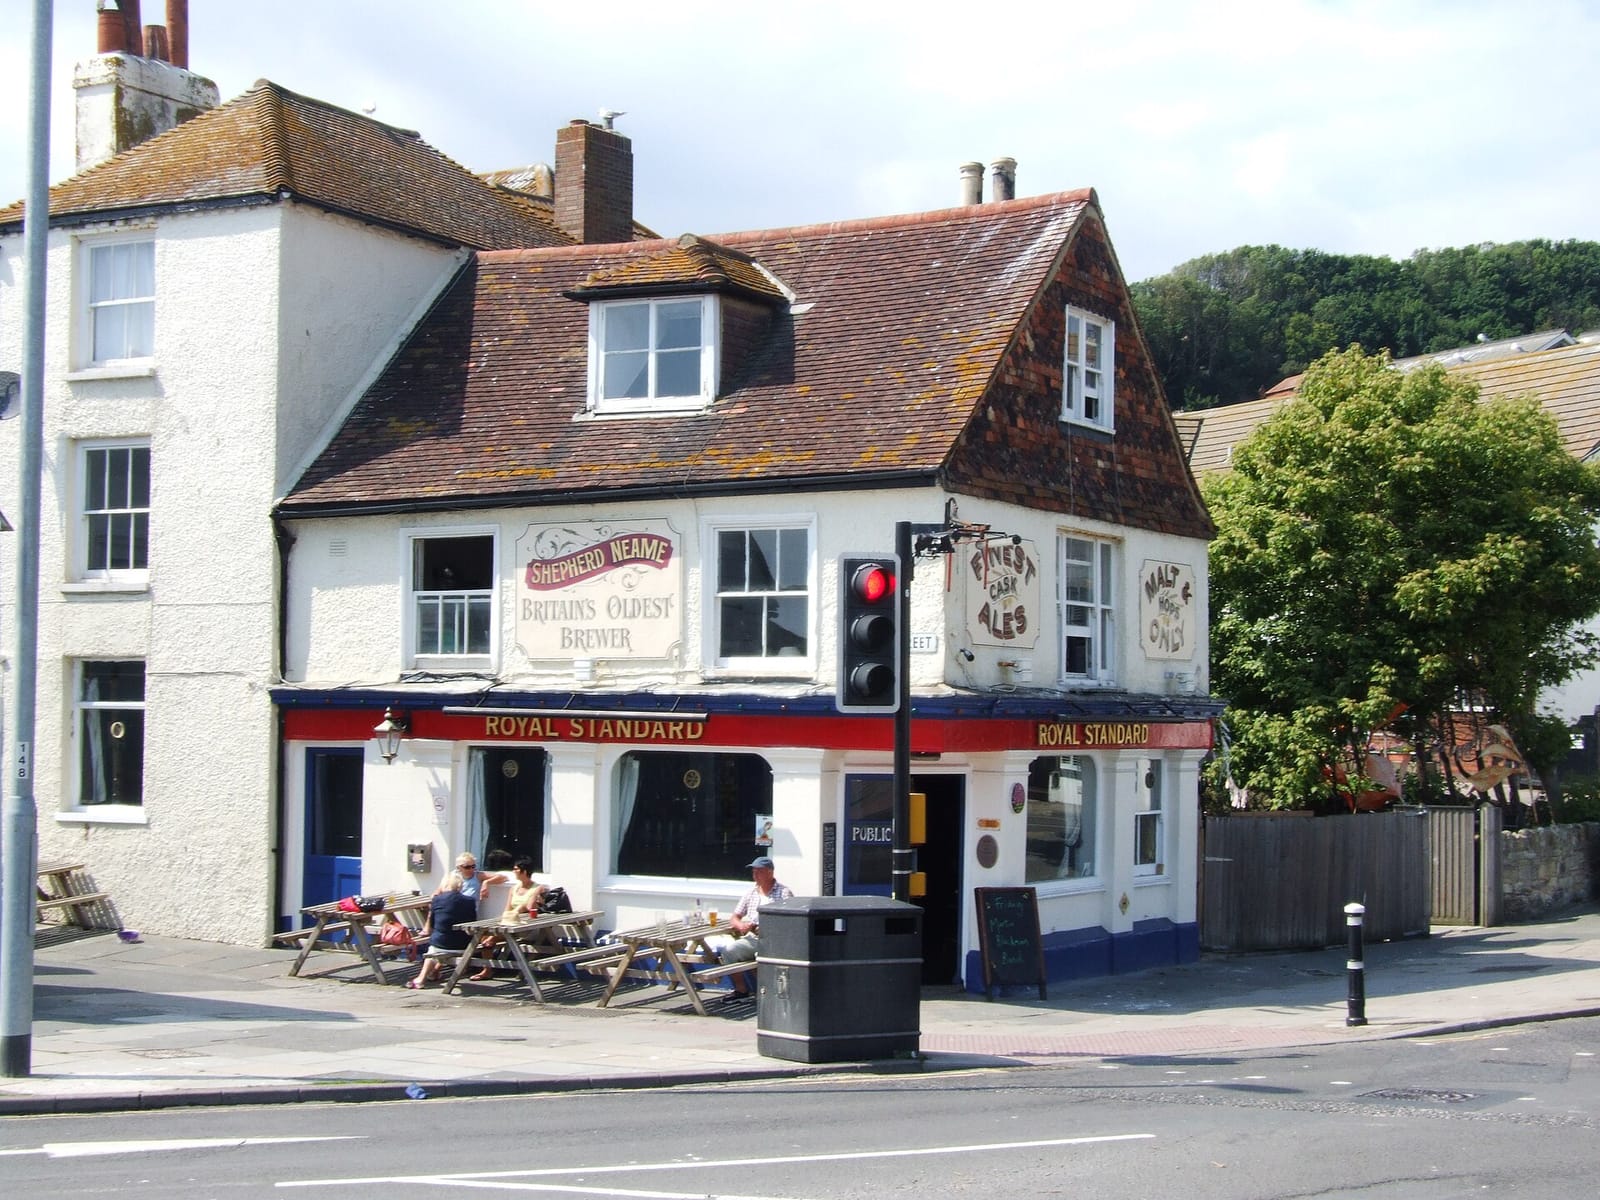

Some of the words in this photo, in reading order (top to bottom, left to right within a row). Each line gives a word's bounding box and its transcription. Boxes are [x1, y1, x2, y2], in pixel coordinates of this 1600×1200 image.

[531, 548, 605, 586] SHEPHERD
[609, 537, 669, 564] NEAME
[989, 575, 1018, 601] CASK
[1145, 564, 1180, 605] MALT
[1182, 581, 1193, 605] &
[521, 597, 597, 625] BRITAIN'S
[606, 593, 675, 620] OLDEST
[977, 601, 1028, 640] ALES
[1158, 596, 1180, 620] HOPS
[560, 627, 633, 653] BREWER
[1150, 618, 1185, 653] ONLY
[485, 715, 560, 738] ROYAL
[569, 717, 705, 740] STANDARD
[1038, 723, 1081, 746] ROYAL
[1084, 723, 1150, 745] STANDARD
[852, 826, 892, 842] PUBLIC
